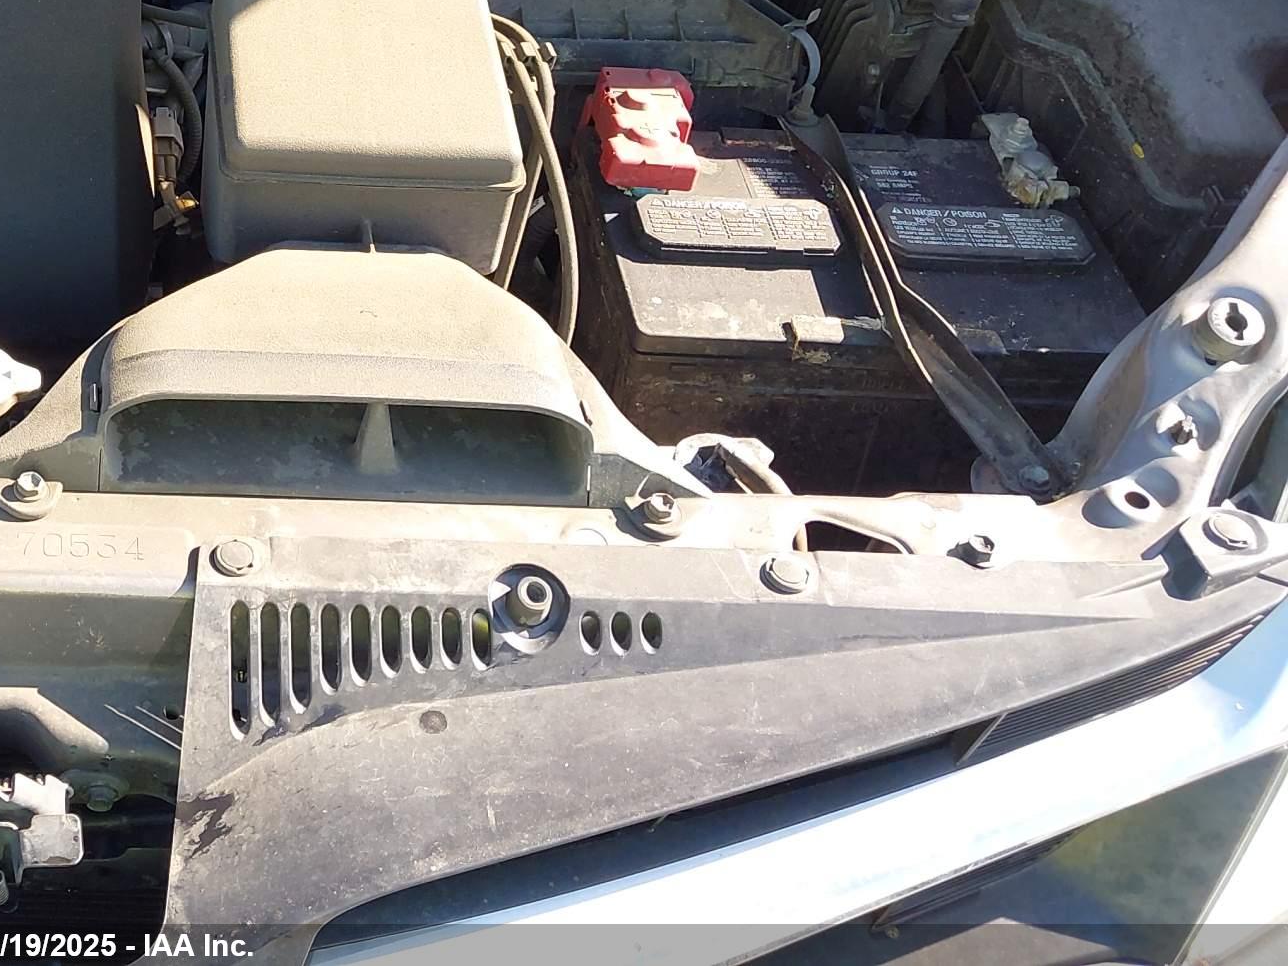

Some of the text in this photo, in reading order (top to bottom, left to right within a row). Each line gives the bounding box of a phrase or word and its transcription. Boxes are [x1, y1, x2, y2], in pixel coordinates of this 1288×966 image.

[903, 207, 943, 217] DANGER
[950, 210, 987, 219] POISON
[15, 532, 145, 561] 70534
